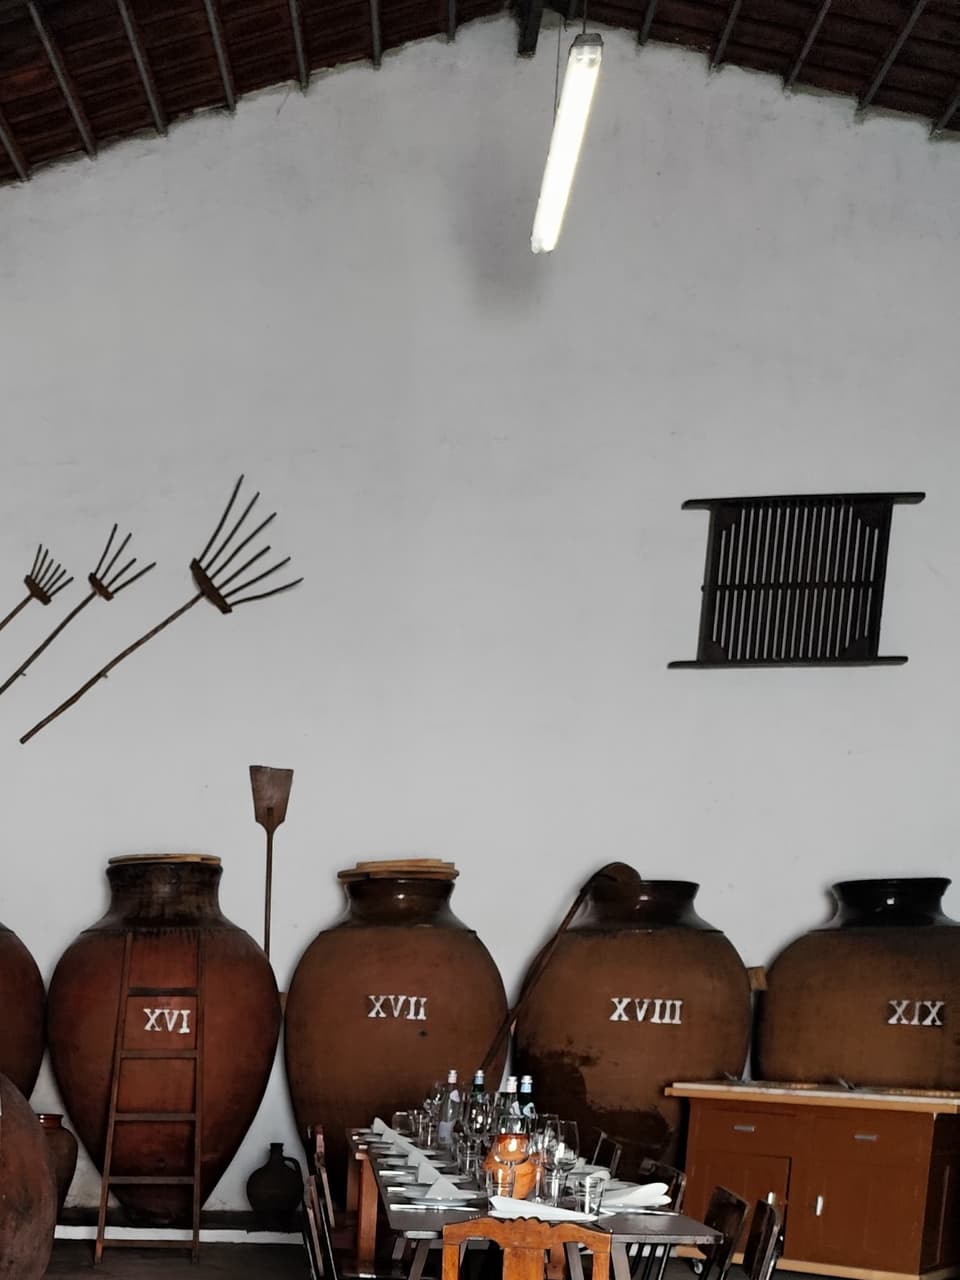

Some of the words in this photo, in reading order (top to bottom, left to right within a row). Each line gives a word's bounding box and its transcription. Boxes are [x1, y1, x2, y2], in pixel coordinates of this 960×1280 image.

[368, 995, 427, 1020] XVII
[608, 997, 683, 1025] XVIII
[888, 1000, 945, 1026] XIX
[143, 1008, 191, 1034] XVI
